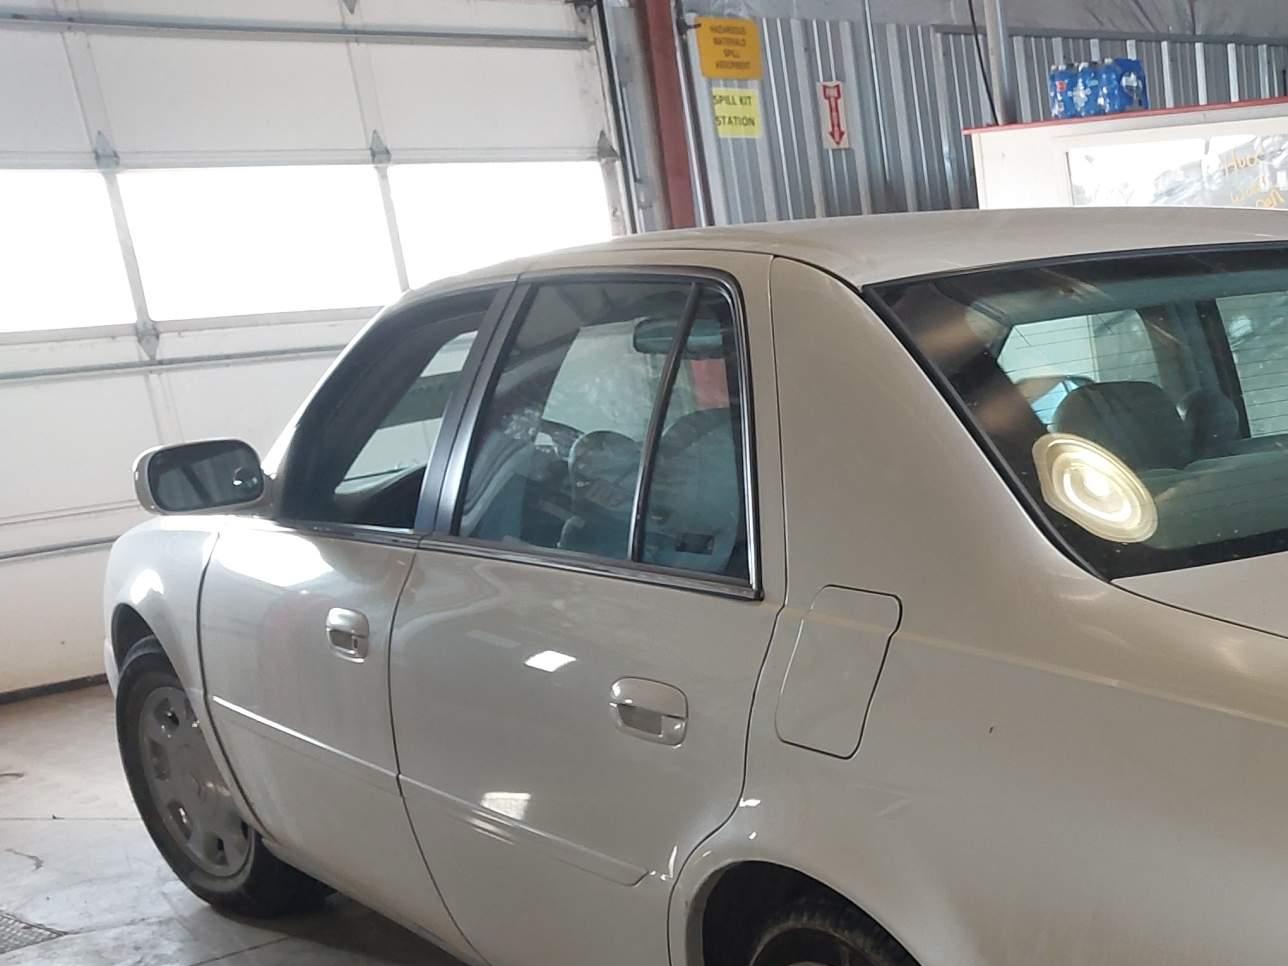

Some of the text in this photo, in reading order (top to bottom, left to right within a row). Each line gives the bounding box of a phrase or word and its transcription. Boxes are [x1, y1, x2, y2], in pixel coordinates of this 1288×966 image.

[713, 95, 752, 106] SPILL KIT
[715, 115, 756, 127] STATION
